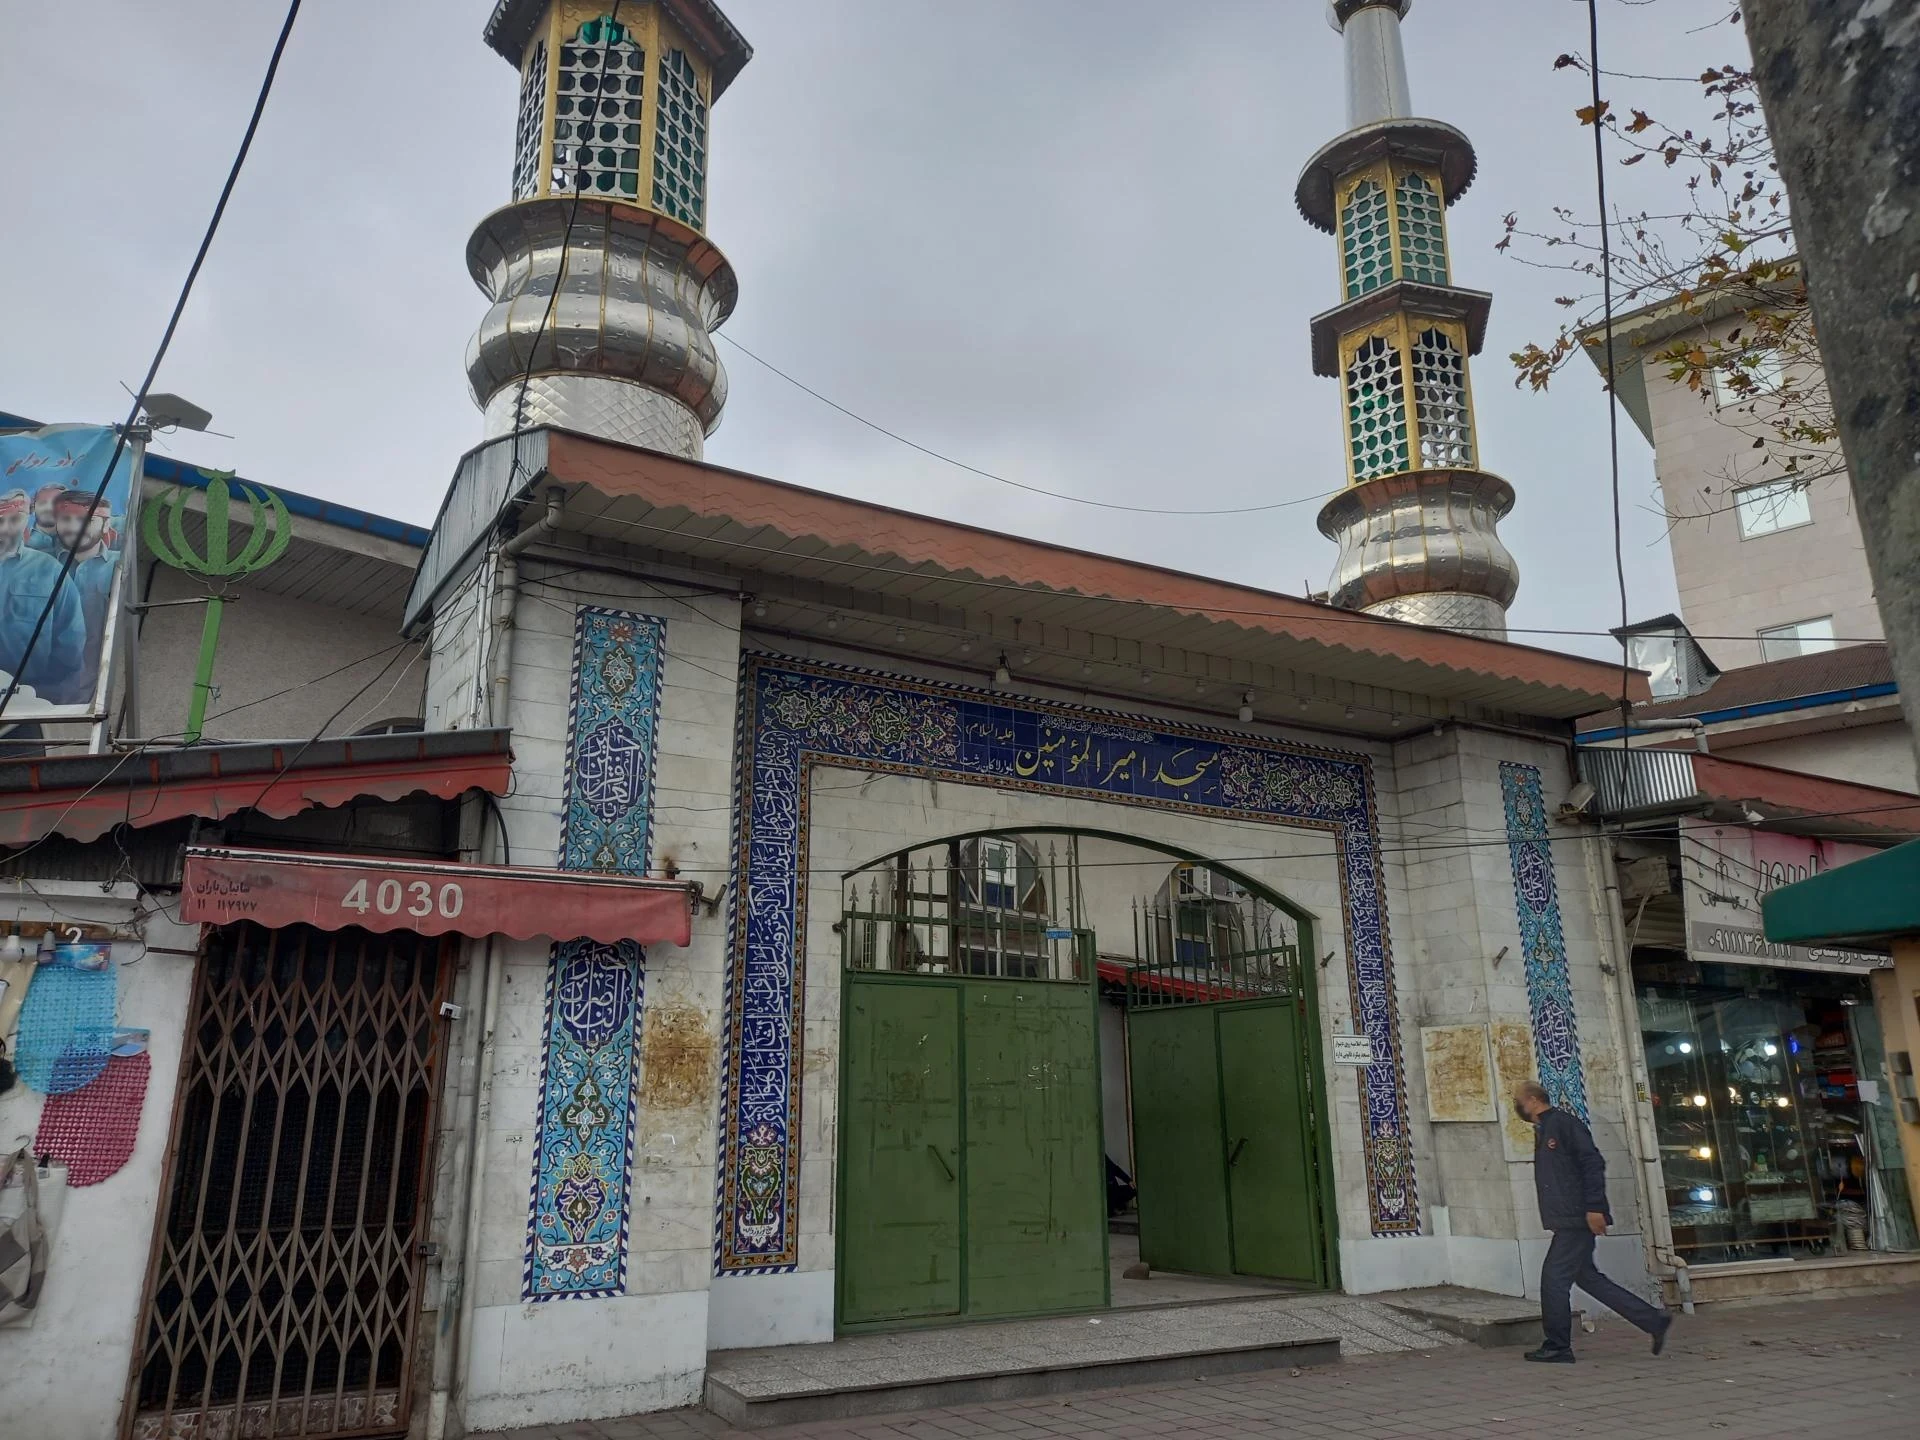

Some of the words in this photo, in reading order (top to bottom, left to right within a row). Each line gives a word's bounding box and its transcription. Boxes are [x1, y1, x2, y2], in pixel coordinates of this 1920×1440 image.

[959, 752, 981, 771] رشت
[1099, 749, 1147, 786] امیر
[1152, 747, 1219, 800] مسجد
[197, 879, 220, 896] باران
[342, 877, 464, 918] 4030
